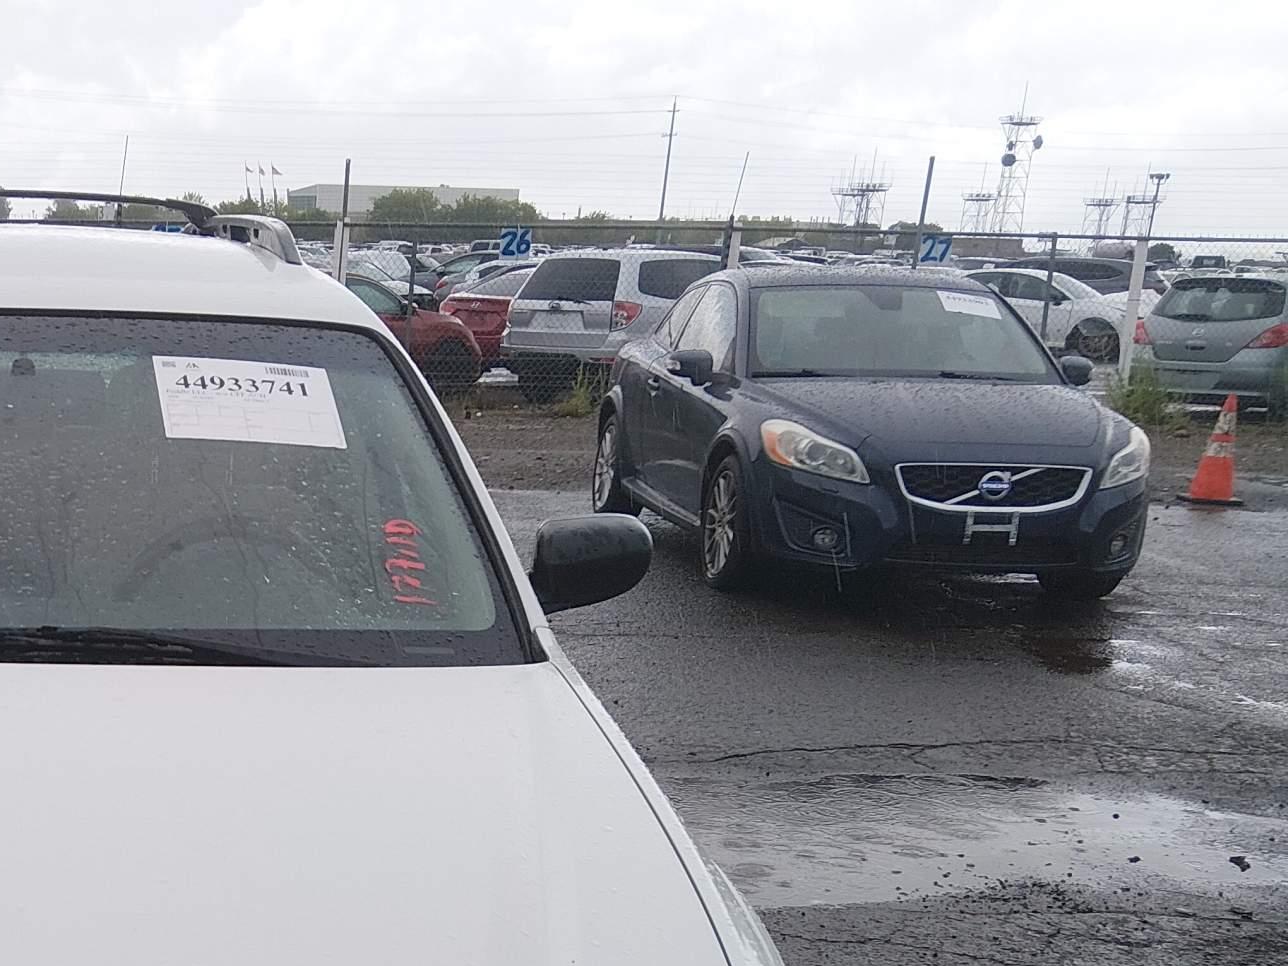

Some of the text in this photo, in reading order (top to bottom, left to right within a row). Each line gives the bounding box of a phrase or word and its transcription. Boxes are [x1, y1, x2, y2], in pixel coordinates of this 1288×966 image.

[500, 230, 531, 256] 26
[920, 234, 952, 263] 27
[175, 374, 309, 397] 44933741
